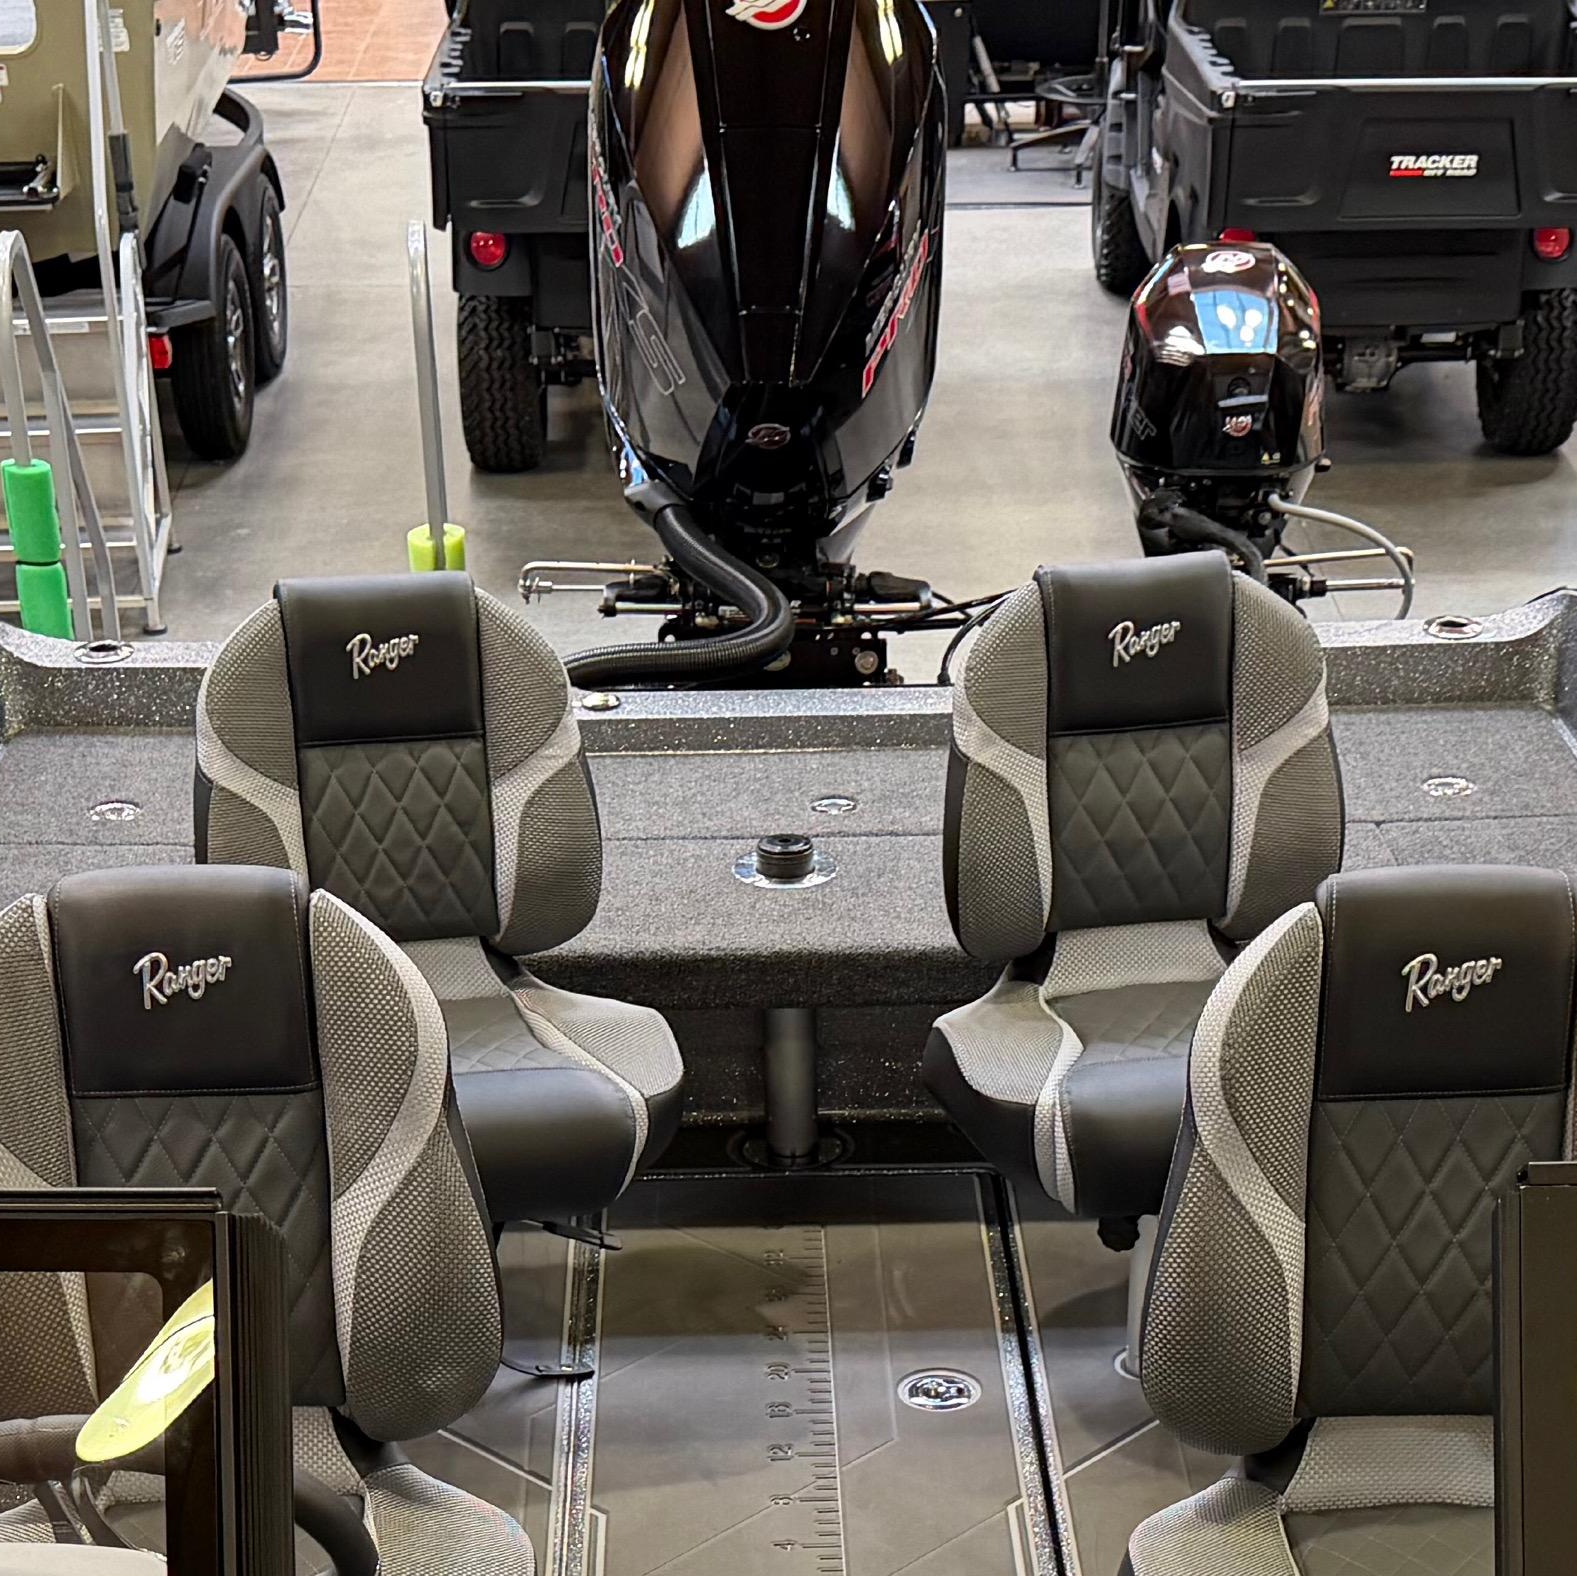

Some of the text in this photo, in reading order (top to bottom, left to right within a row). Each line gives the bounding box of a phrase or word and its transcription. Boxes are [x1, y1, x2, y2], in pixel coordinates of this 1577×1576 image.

[1390, 155, 1479, 169] TRACKER
[346, 633, 419, 680] Ranger
[1107, 621, 1181, 668] Ranger
[133, 952, 232, 1009] Ranger
[1401, 953, 1502, 1012] Ranger
